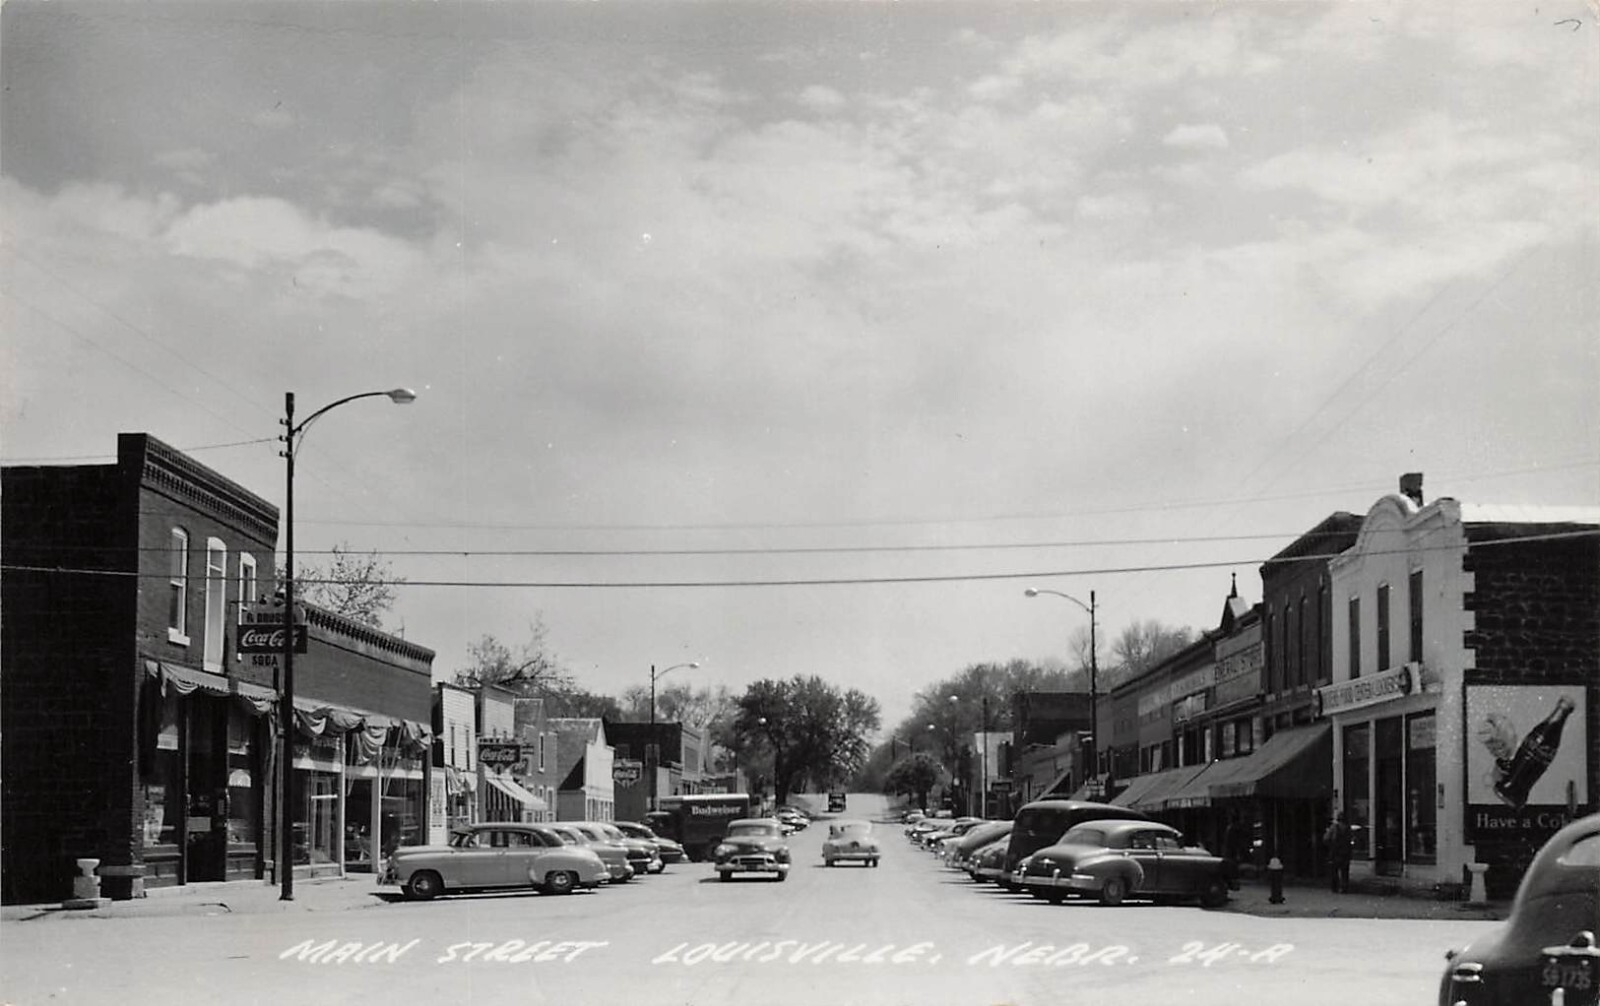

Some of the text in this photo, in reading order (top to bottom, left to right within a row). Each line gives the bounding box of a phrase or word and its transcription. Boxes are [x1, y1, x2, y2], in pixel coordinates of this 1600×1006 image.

[252, 655, 278, 667] SODA
[691, 804, 742, 816] Budweiser
[1477, 813, 1516, 828] Have
[1522, 818, 1531, 828] a
